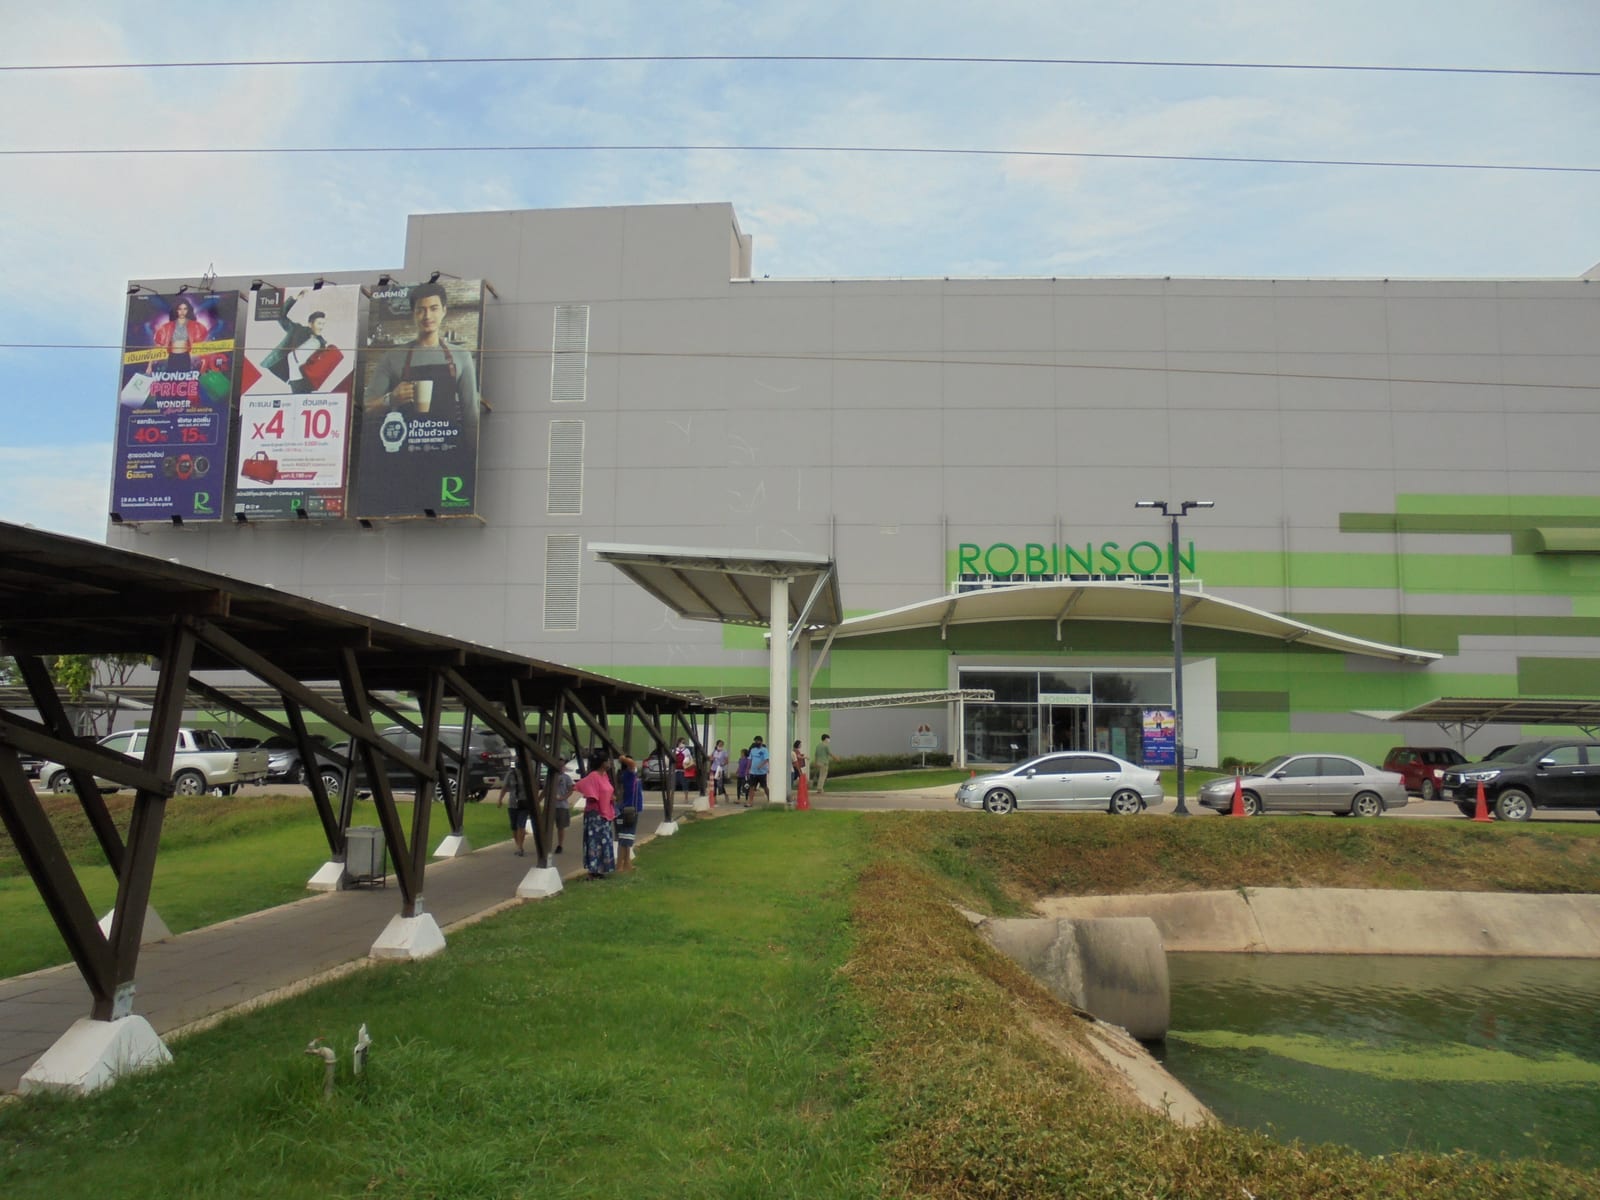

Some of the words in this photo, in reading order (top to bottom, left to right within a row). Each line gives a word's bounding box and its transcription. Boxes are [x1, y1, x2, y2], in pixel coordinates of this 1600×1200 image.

[261, 297, 275, 305] The
[275, 292, 283, 305] 1
[372, 290, 408, 299] GARMIN
[151, 371, 200, 381] WONDER
[150, 381, 198, 396] PRICE
[156, 400, 191, 408] WONDER
[251, 409, 284, 439] x4
[441, 476, 469, 502] R
[194, 491, 214, 511] R
[958, 541, 1195, 577] ROBINSON
